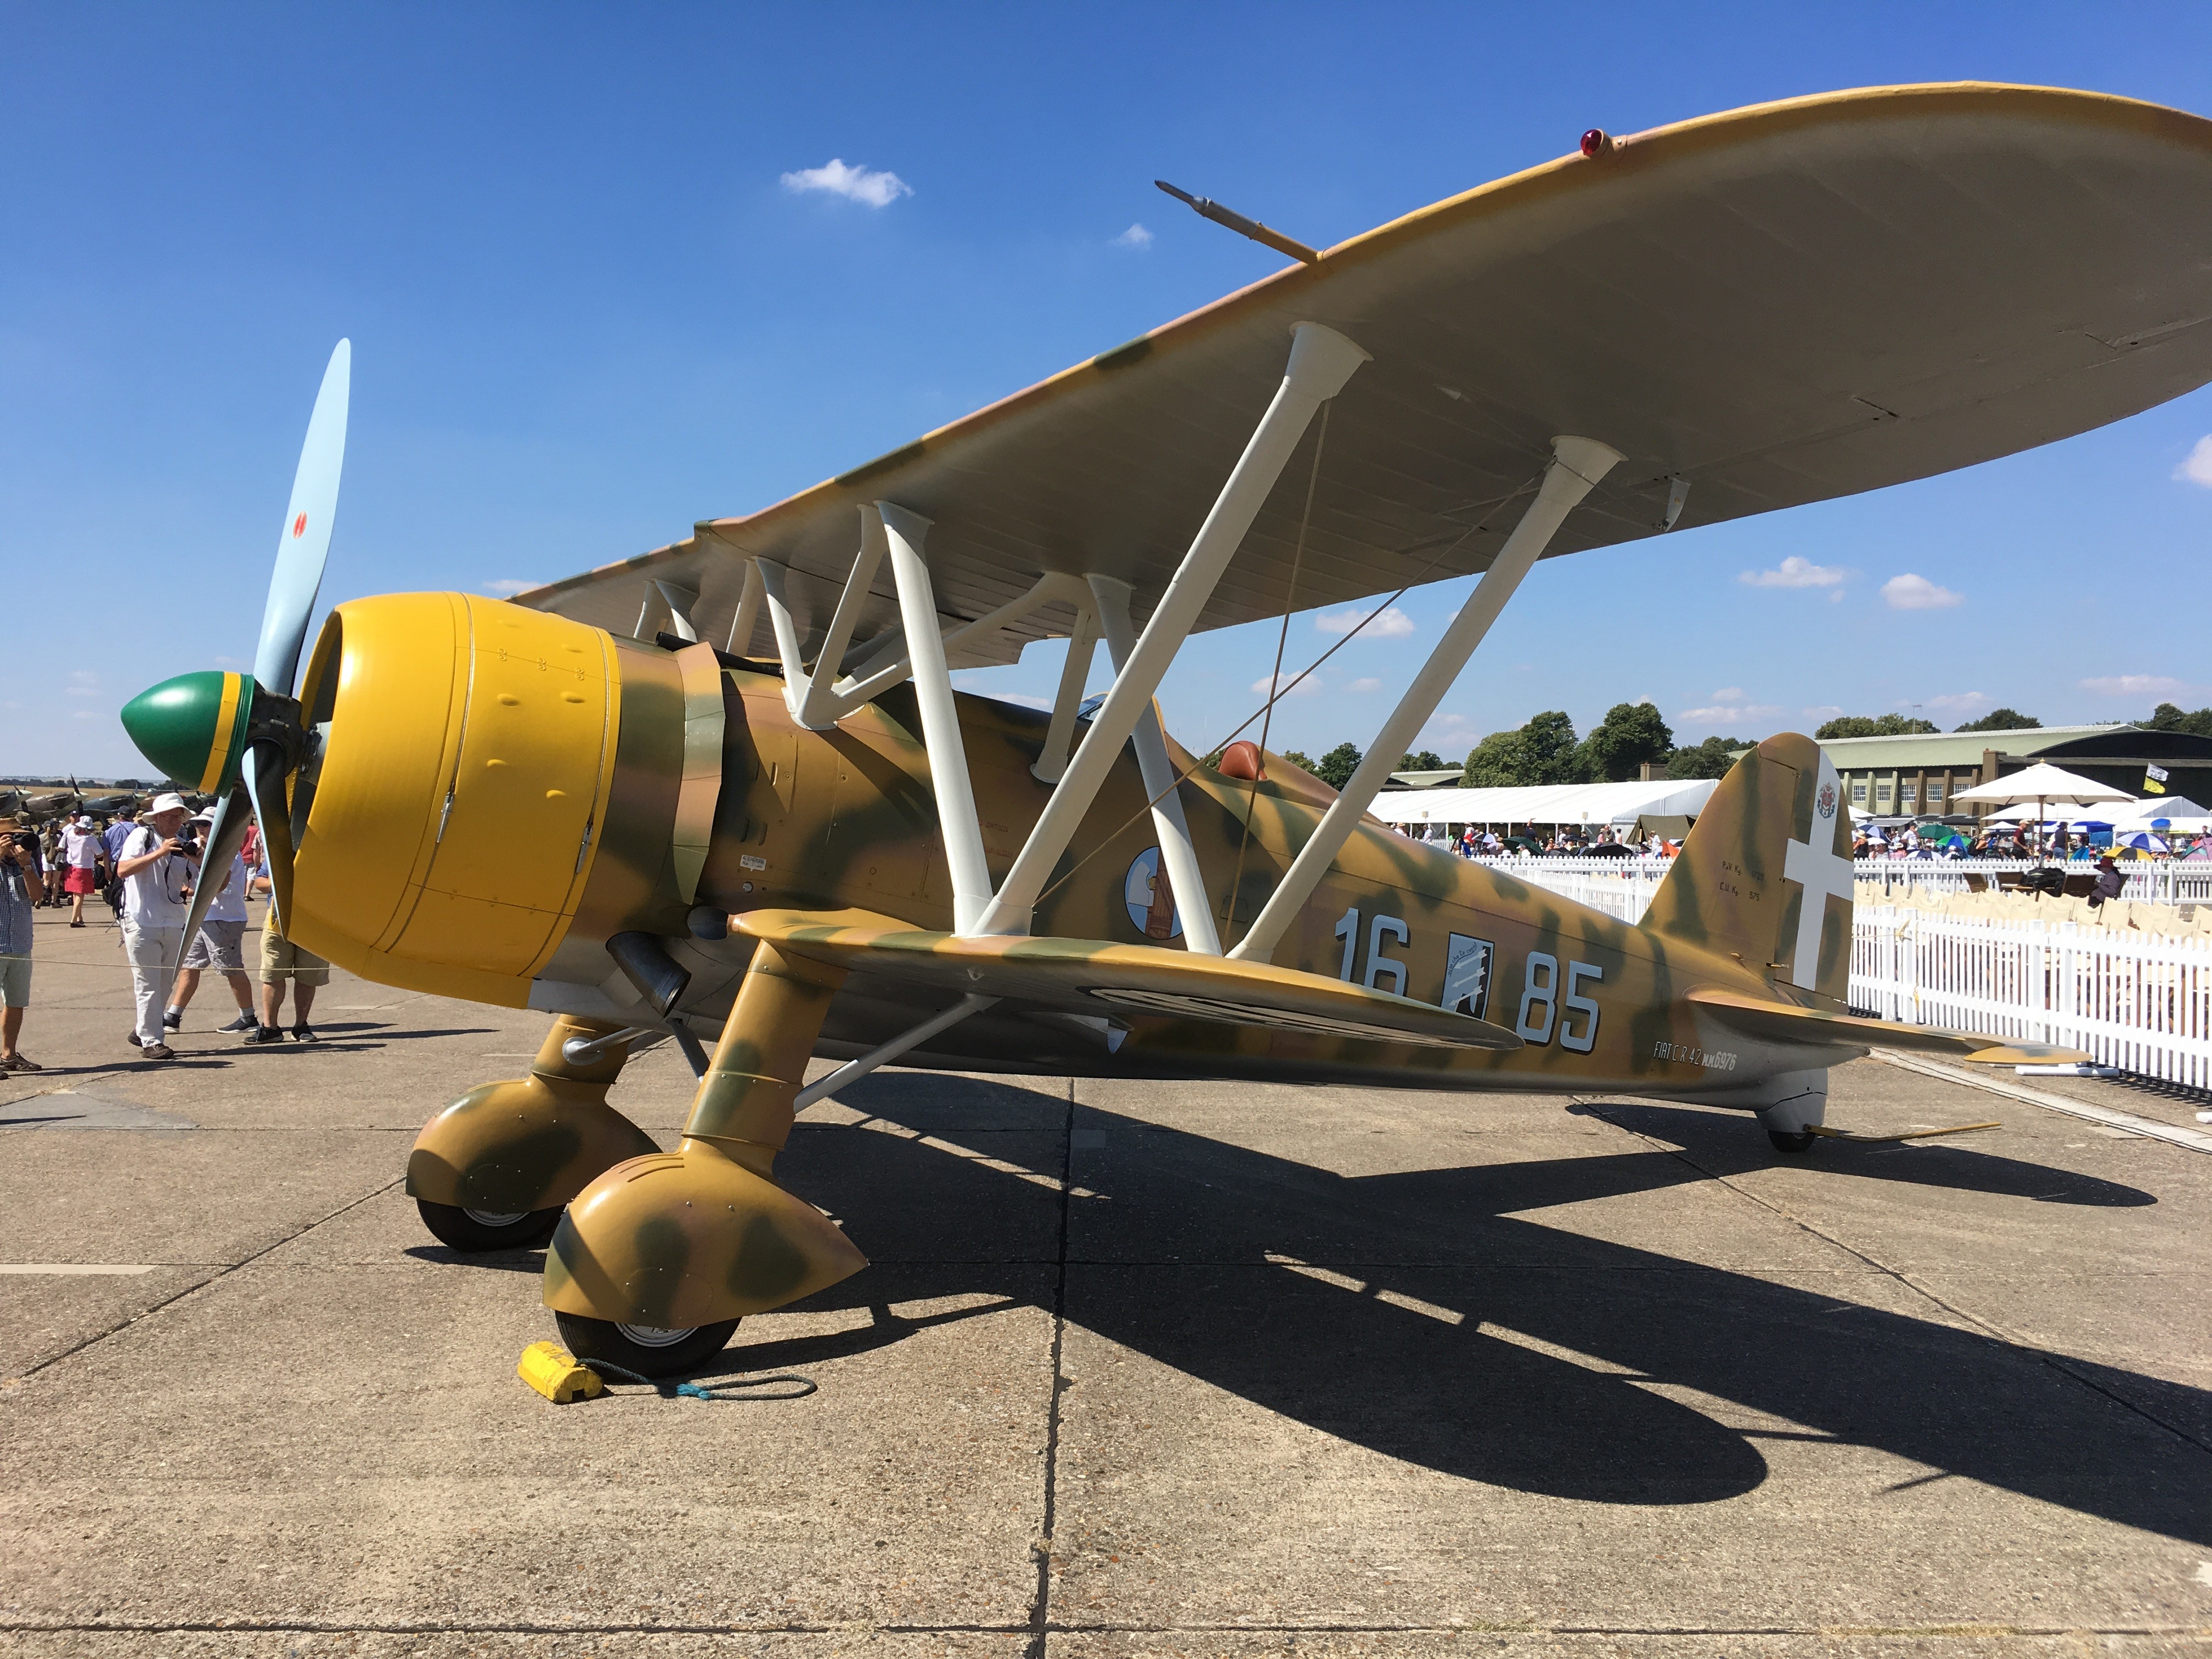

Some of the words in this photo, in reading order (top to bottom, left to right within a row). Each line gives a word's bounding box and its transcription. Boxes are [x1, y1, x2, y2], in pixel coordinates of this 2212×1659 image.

[1750, 891, 1760, 901] 575
[1335, 907, 1410, 997] 16
[1515, 951, 1604, 1054] 85
[1653, 1041, 1672, 1059] FIAT
